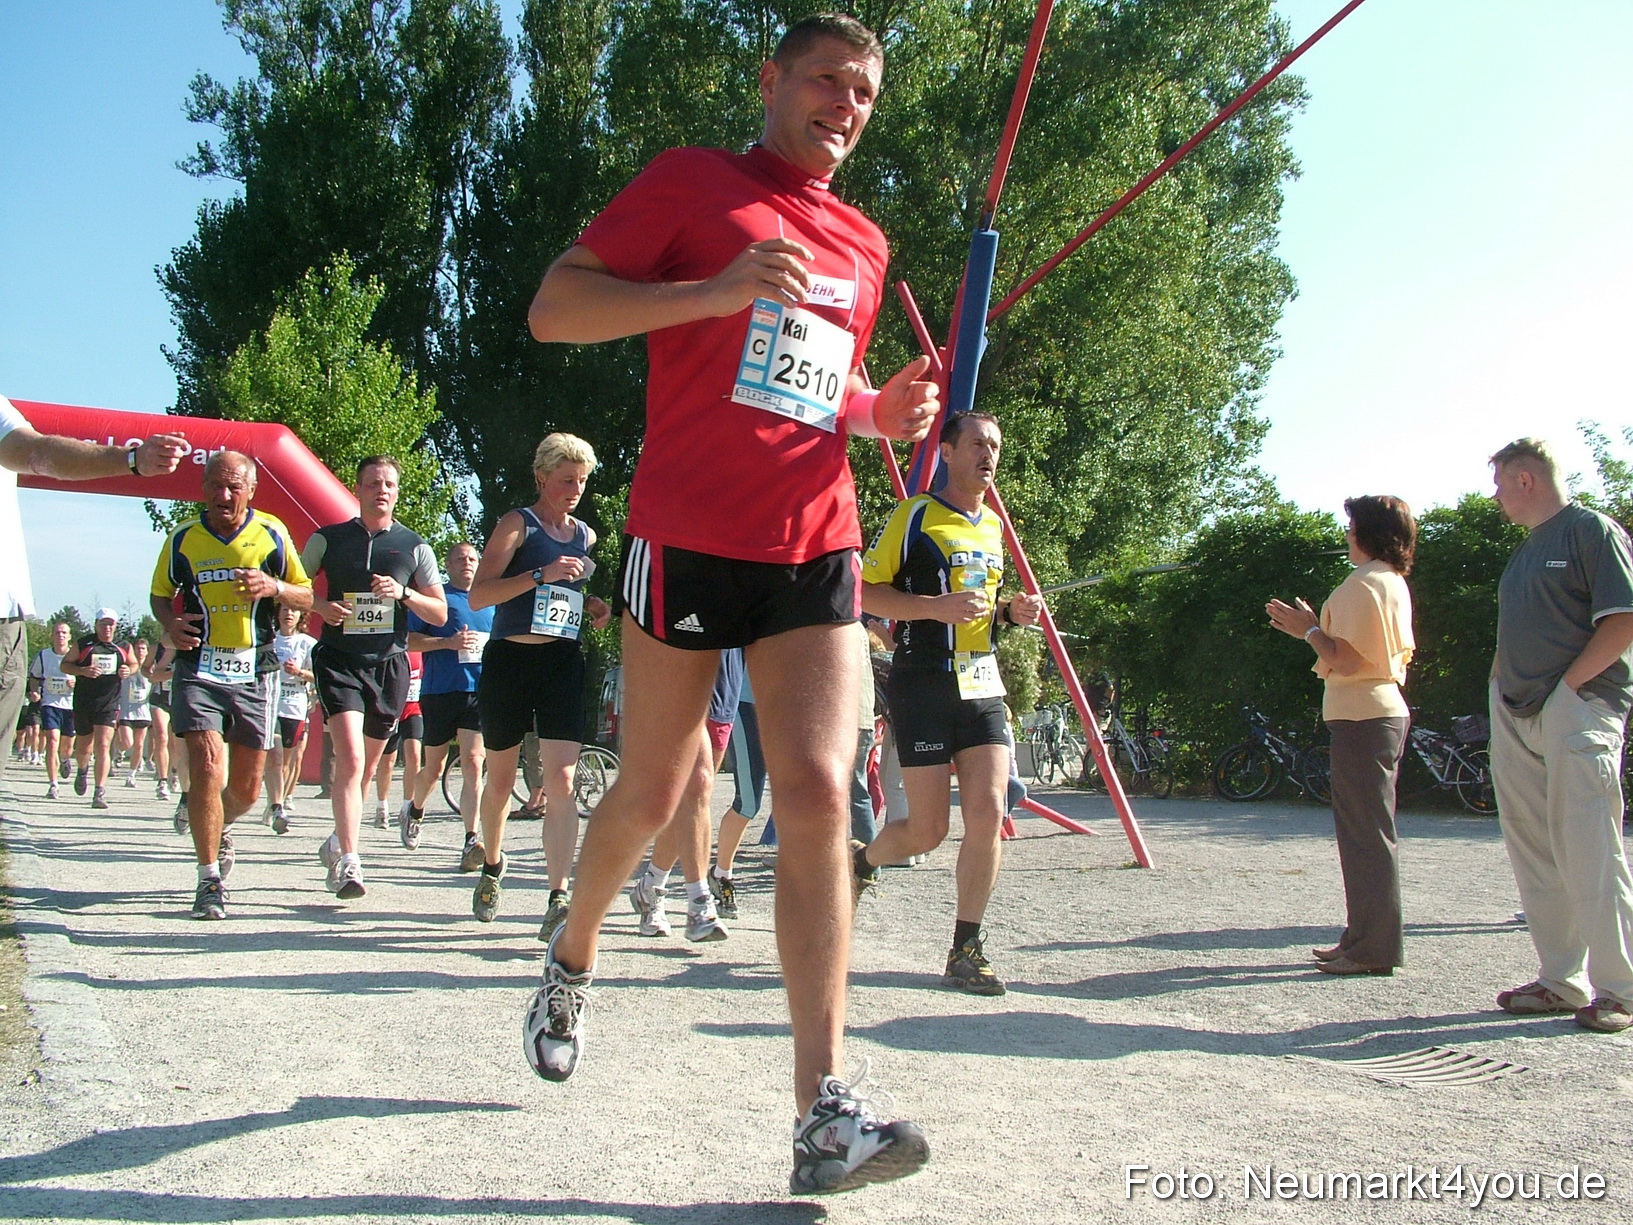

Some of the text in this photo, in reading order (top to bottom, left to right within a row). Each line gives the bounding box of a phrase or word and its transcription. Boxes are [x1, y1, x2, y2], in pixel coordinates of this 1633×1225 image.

[782, 317, 808, 342] Kai
[752, 338, 766, 355] C
[774, 353, 838, 401] 2510
[736, 386, 783, 407] BOCK
[356, 597, 383, 605] Markus
[550, 590, 569, 603] Anita
[537, 602, 544, 611] C
[357, 610, 383, 623] 494
[549, 607, 580, 627] 2782
[202, 654, 209, 662] D
[214, 659, 251, 674] 3133
[960, 664, 966, 673] B
